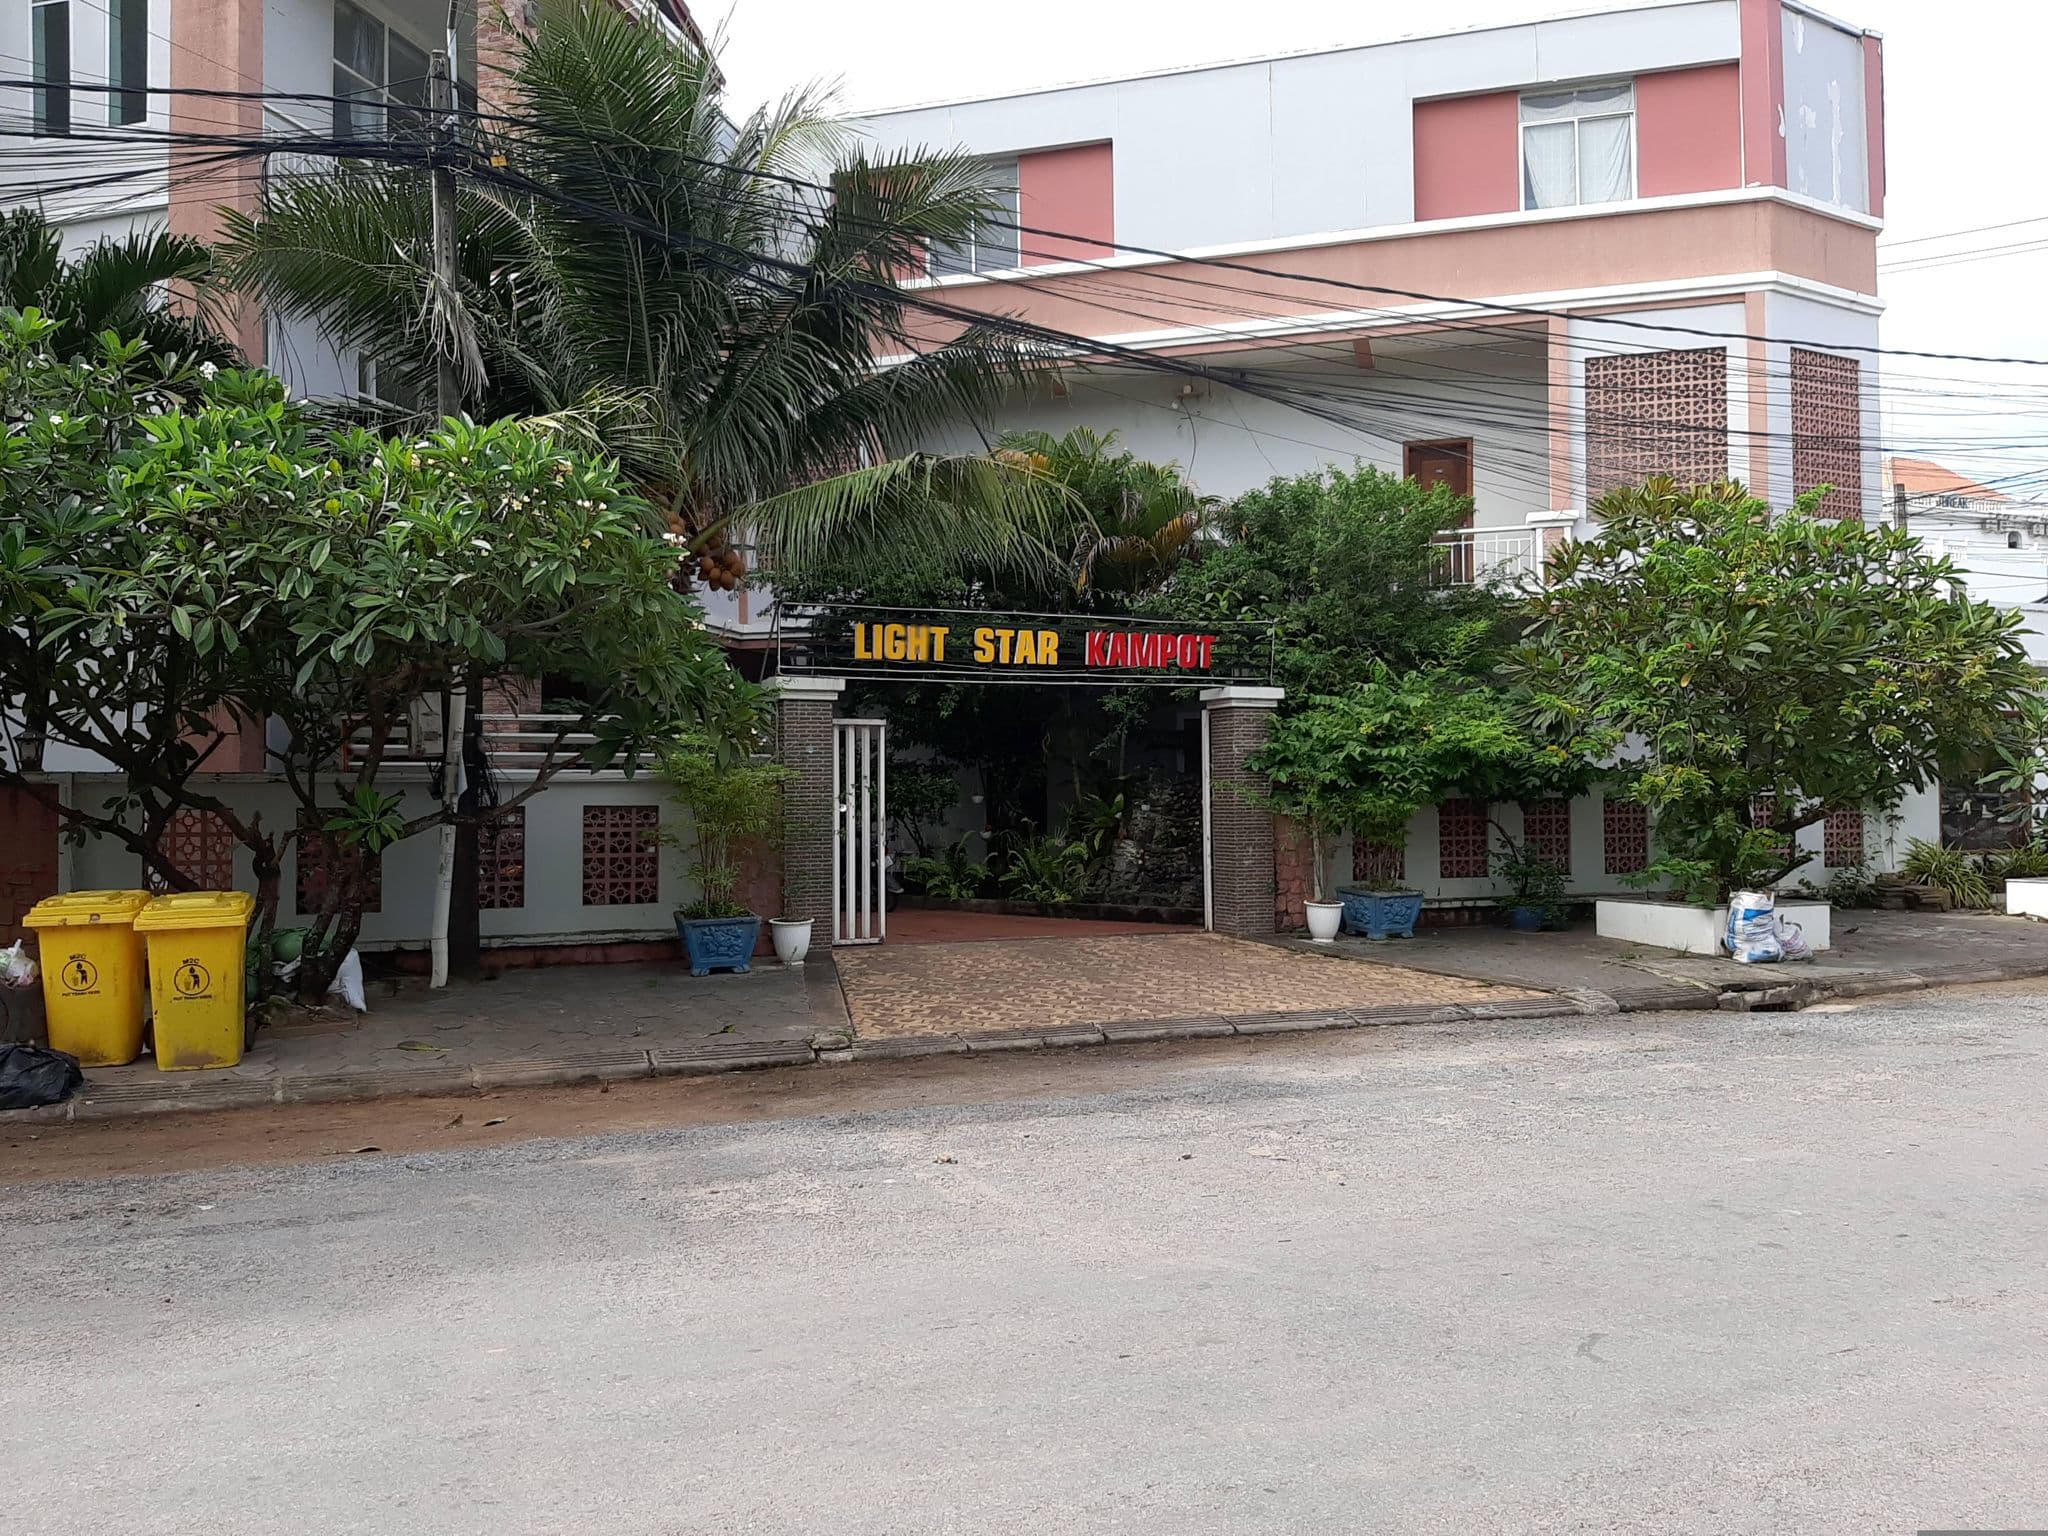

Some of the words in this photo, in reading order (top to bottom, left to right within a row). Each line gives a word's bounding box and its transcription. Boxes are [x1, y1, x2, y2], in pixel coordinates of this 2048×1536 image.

[854, 623, 949, 662] LIGHT
[973, 627, 1059, 665] STAR
[1085, 630, 1216, 669] KAMPOT
